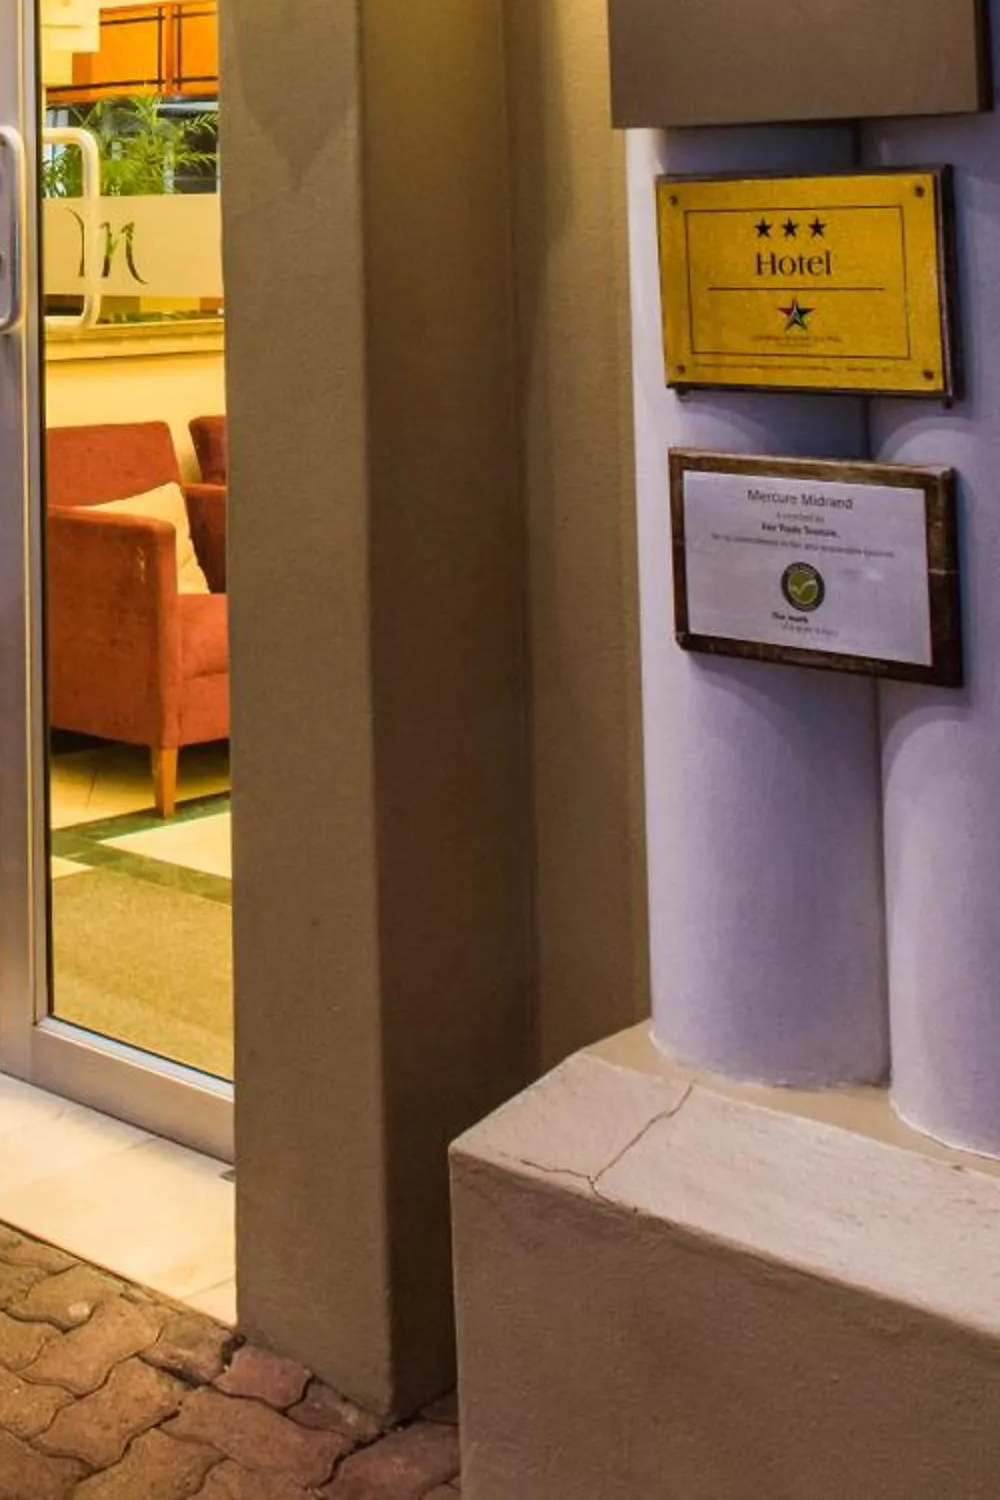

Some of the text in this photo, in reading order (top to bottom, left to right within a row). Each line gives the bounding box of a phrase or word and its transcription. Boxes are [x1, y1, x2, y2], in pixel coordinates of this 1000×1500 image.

[756, 251, 832, 276] Hotel
[747, 489, 853, 509] Mercure Midrand
